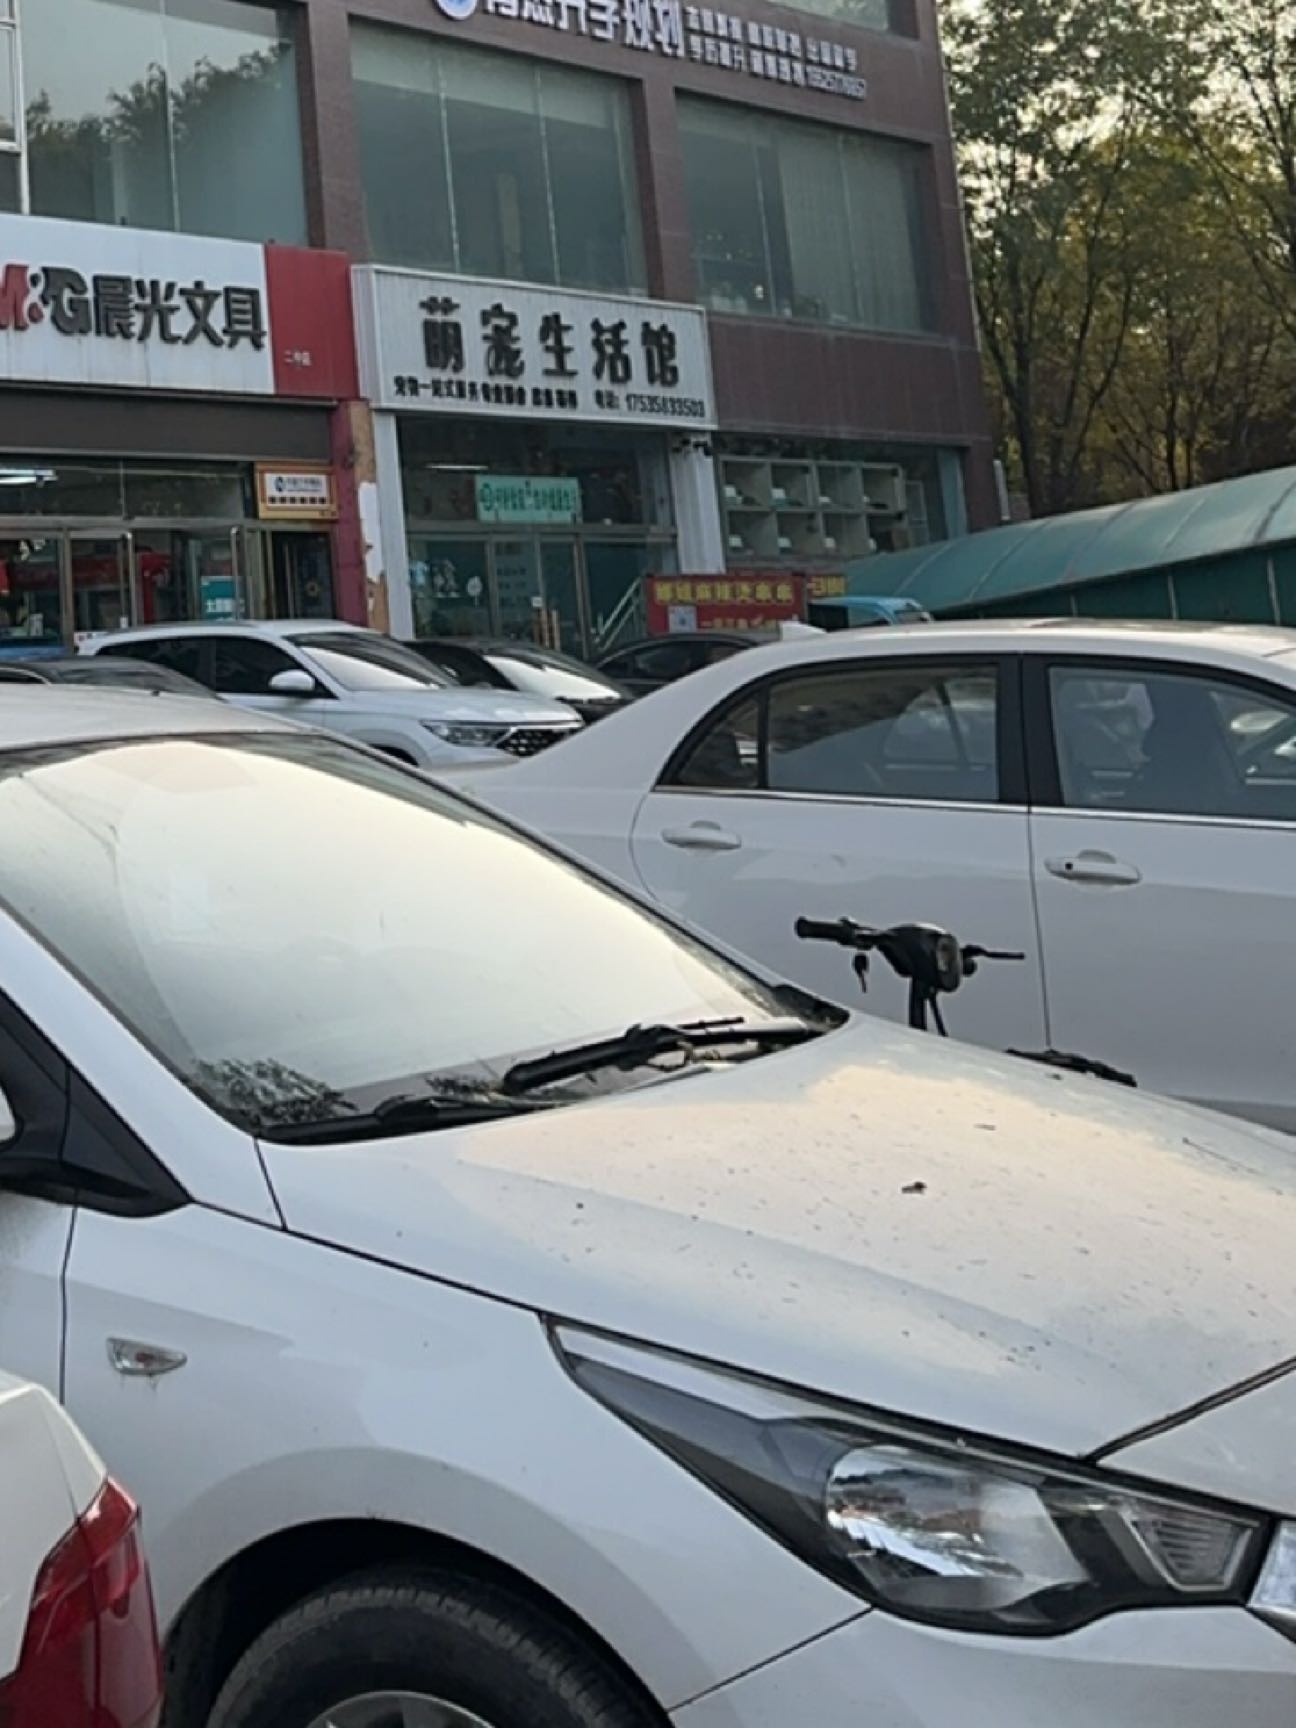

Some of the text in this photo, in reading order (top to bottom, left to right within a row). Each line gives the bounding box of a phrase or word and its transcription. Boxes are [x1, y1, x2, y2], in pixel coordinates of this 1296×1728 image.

[418, 295, 680, 388] 萌宠生活馆
